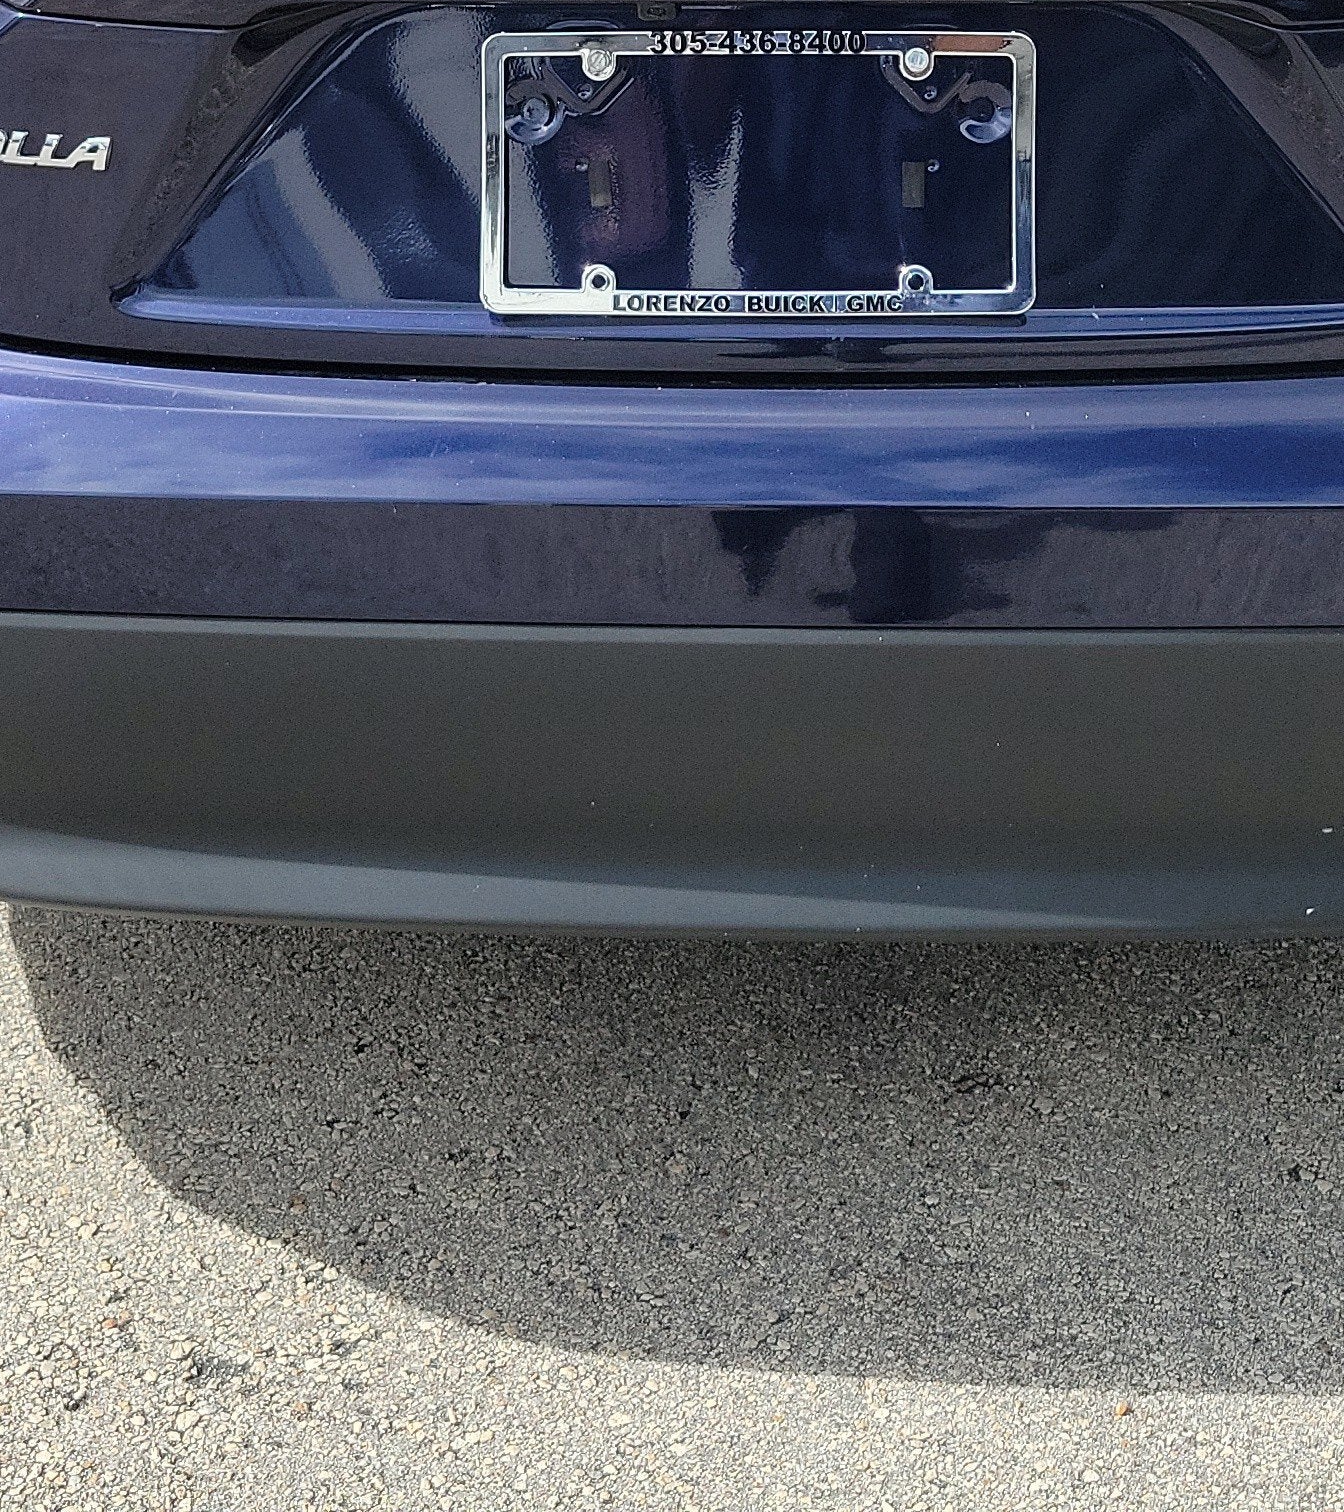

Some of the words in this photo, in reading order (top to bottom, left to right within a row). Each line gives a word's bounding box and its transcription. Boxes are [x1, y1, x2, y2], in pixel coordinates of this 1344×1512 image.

[649, 31, 867, 55] 305-436-8400
[612, 293, 732, 312] LORENZO
[746, 294, 828, 313] BUICK
[846, 293, 904, 313] GMC
